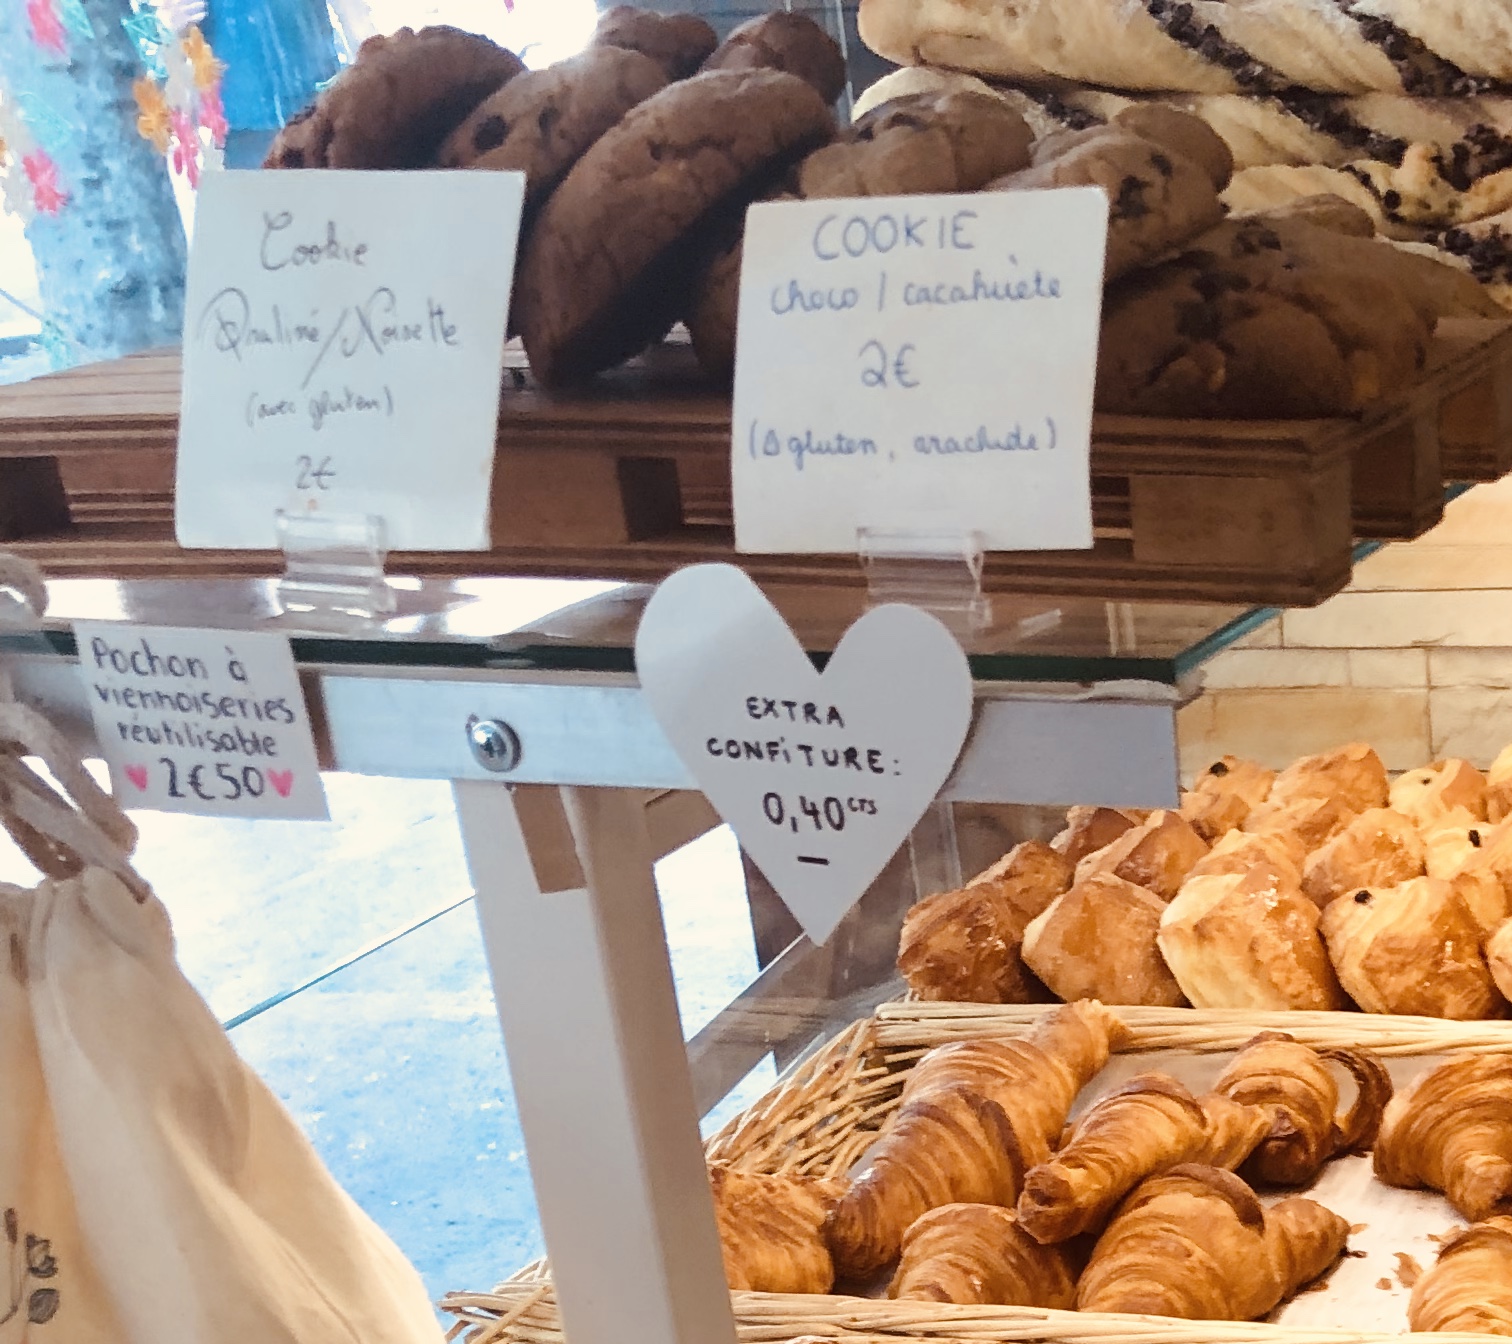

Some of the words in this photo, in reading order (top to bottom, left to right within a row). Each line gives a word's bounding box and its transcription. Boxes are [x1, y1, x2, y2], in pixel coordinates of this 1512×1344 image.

[261, 211, 368, 270] Cookie
[813, 210, 978, 260] COOKIE
[858, 339, 920, 389] 2€
[91, 636, 208, 679] Pochon
[225, 645, 248, 682] à
[94, 684, 295, 724] viennoiseries
[746, 697, 845, 728] EXTRA
[117, 712, 279, 757] réutilisable
